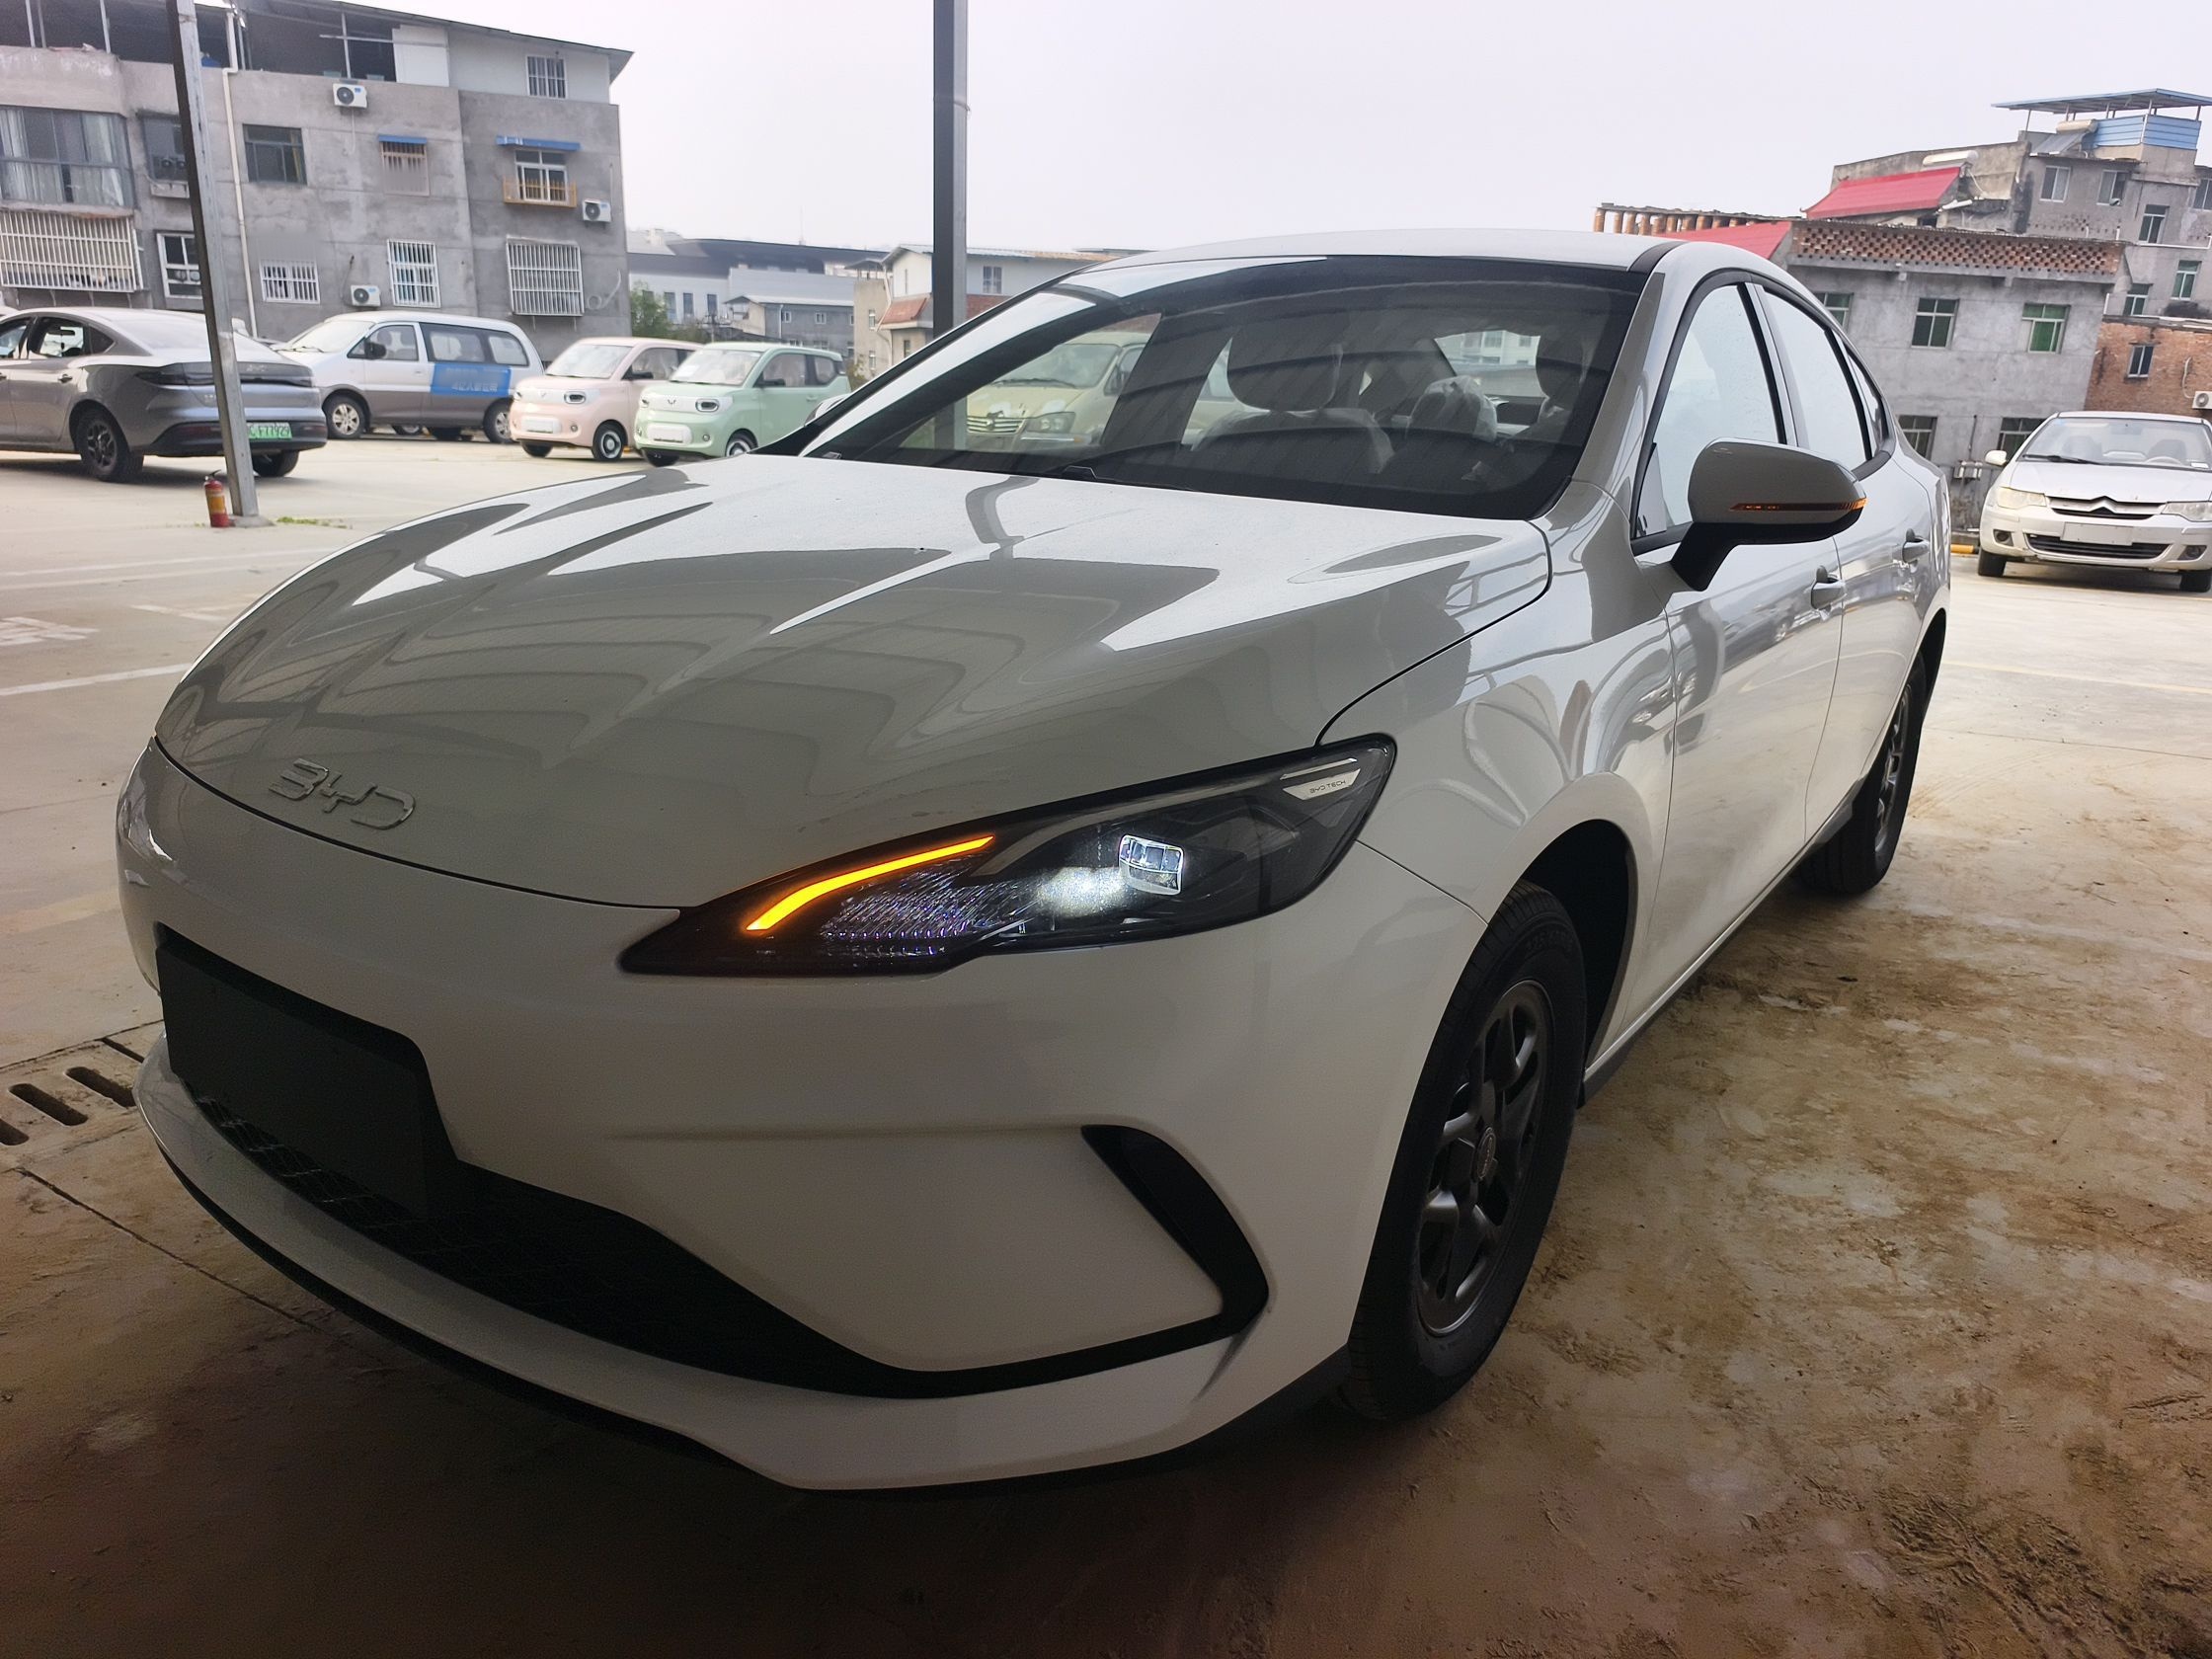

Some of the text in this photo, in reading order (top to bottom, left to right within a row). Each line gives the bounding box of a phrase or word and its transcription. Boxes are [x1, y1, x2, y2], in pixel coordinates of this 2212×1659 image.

[269, 758, 416, 830] BYD
[1309, 780, 1346, 794] BYD TECH
